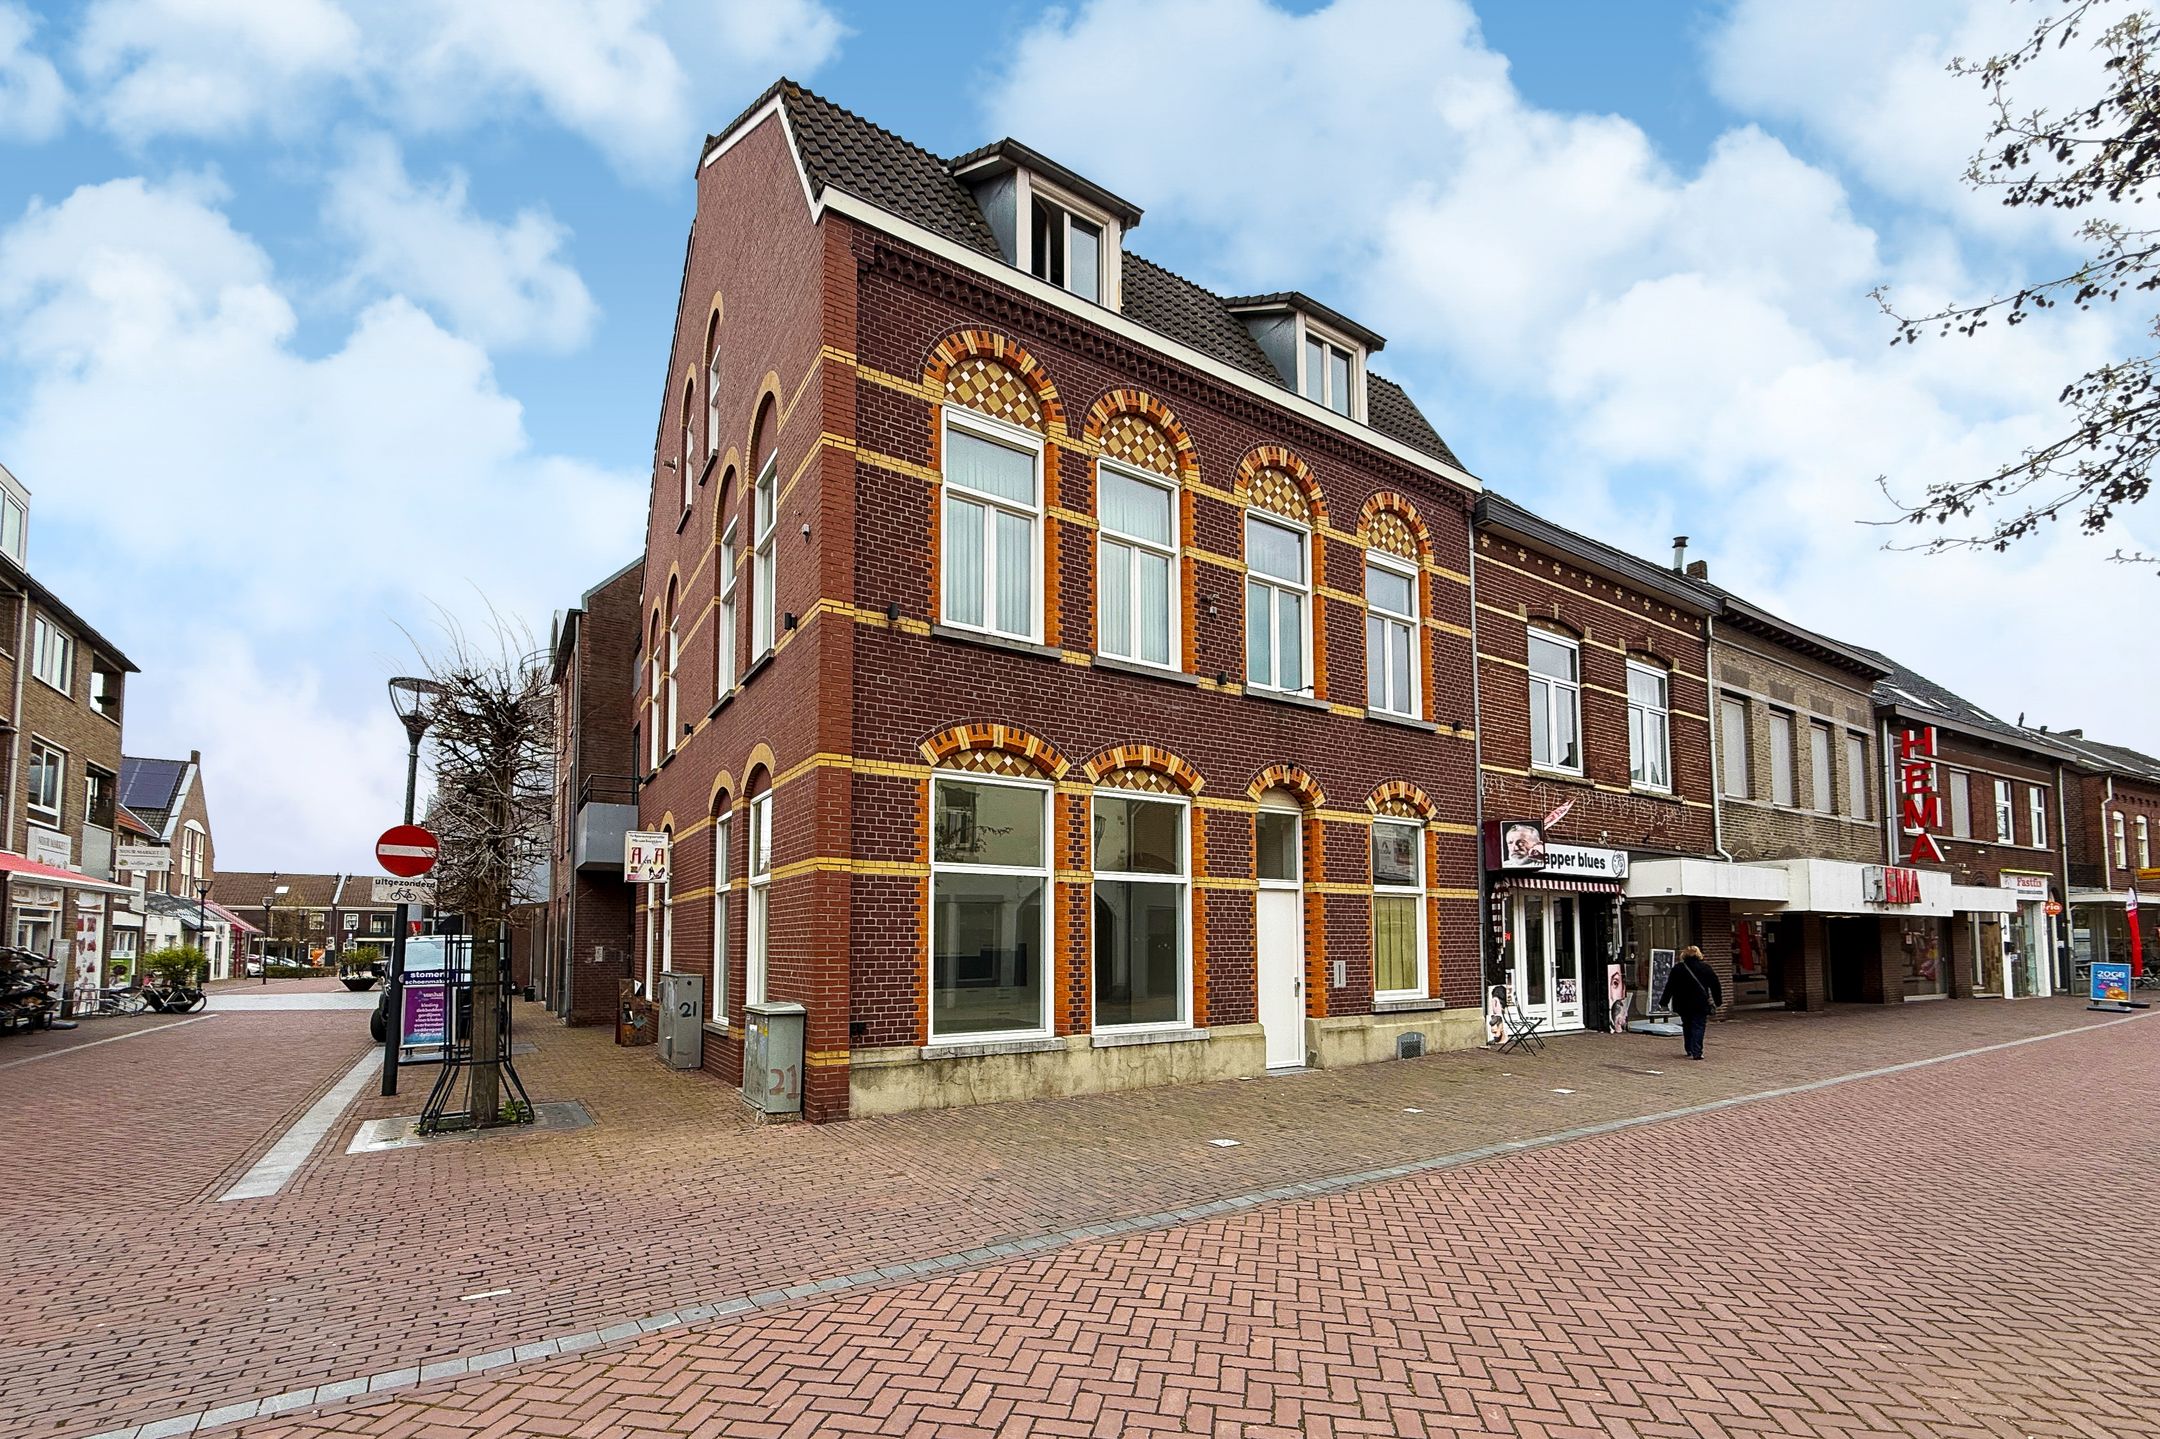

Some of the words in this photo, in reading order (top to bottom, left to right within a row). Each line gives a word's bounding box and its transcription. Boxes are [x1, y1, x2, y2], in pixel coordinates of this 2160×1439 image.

[1901, 726, 1945, 863] HEMA
[630, 847, 641, 864] A
[653, 848, 664, 865] A
[1545, 853, 1575, 869] apper
[1578, 852, 1606, 869] blues
[375, 878, 435, 888] uitgezonderd
[2097, 970, 2126, 979] 20GB
[679, 1001, 698, 1017] 21
[769, 1064, 800, 1099] 21
